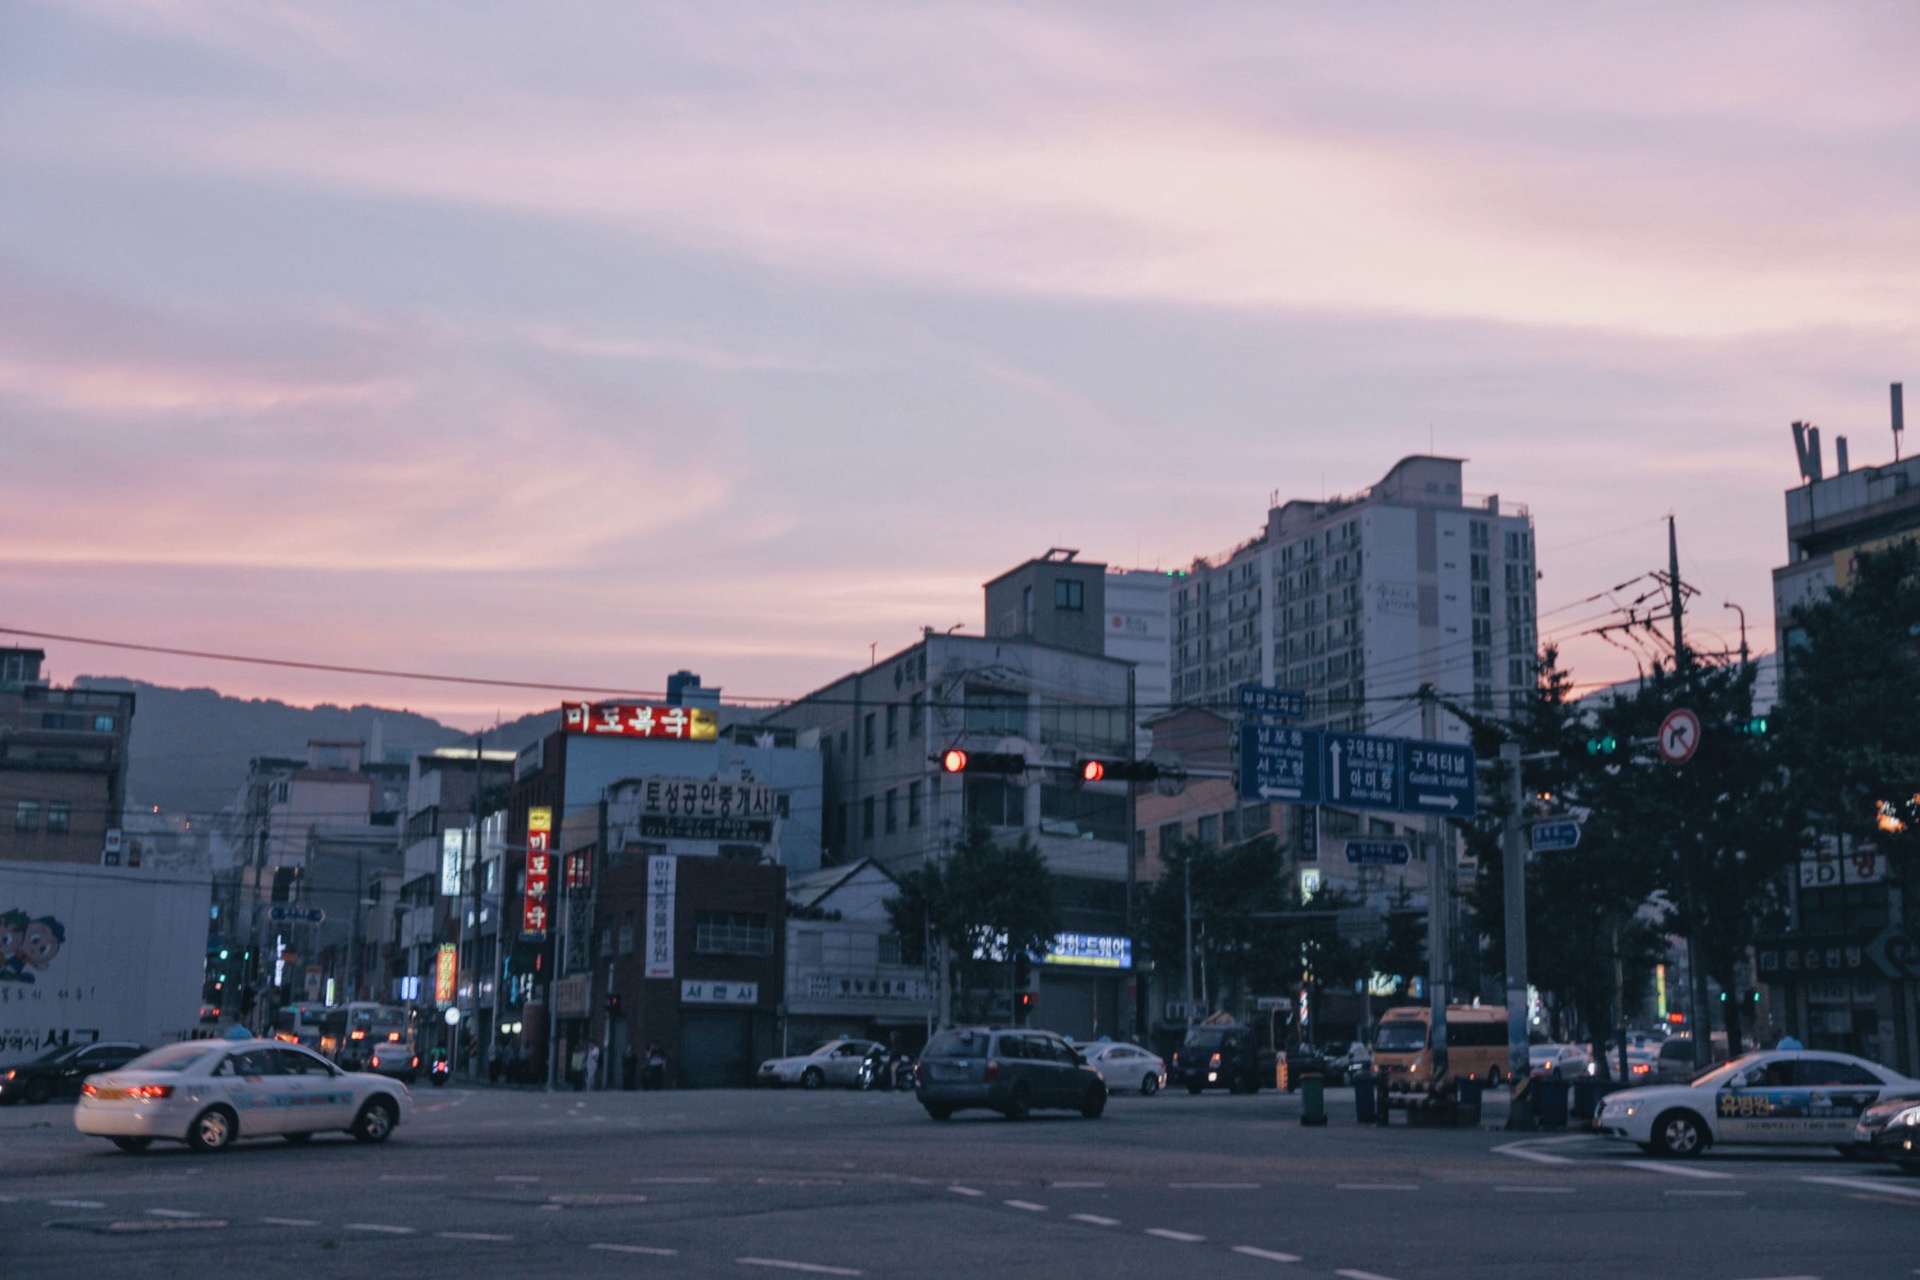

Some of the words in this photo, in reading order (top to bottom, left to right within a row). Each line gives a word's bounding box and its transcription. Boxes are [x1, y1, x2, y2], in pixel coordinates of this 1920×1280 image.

[566, 702, 689, 738] 미도복국
[1350, 768, 1393, 790] 아미동
[1410, 750, 1465, 774] 구덕터널
[645, 781, 769, 818] 토성공인중개사
[526, 832, 548, 929] 미도복국
